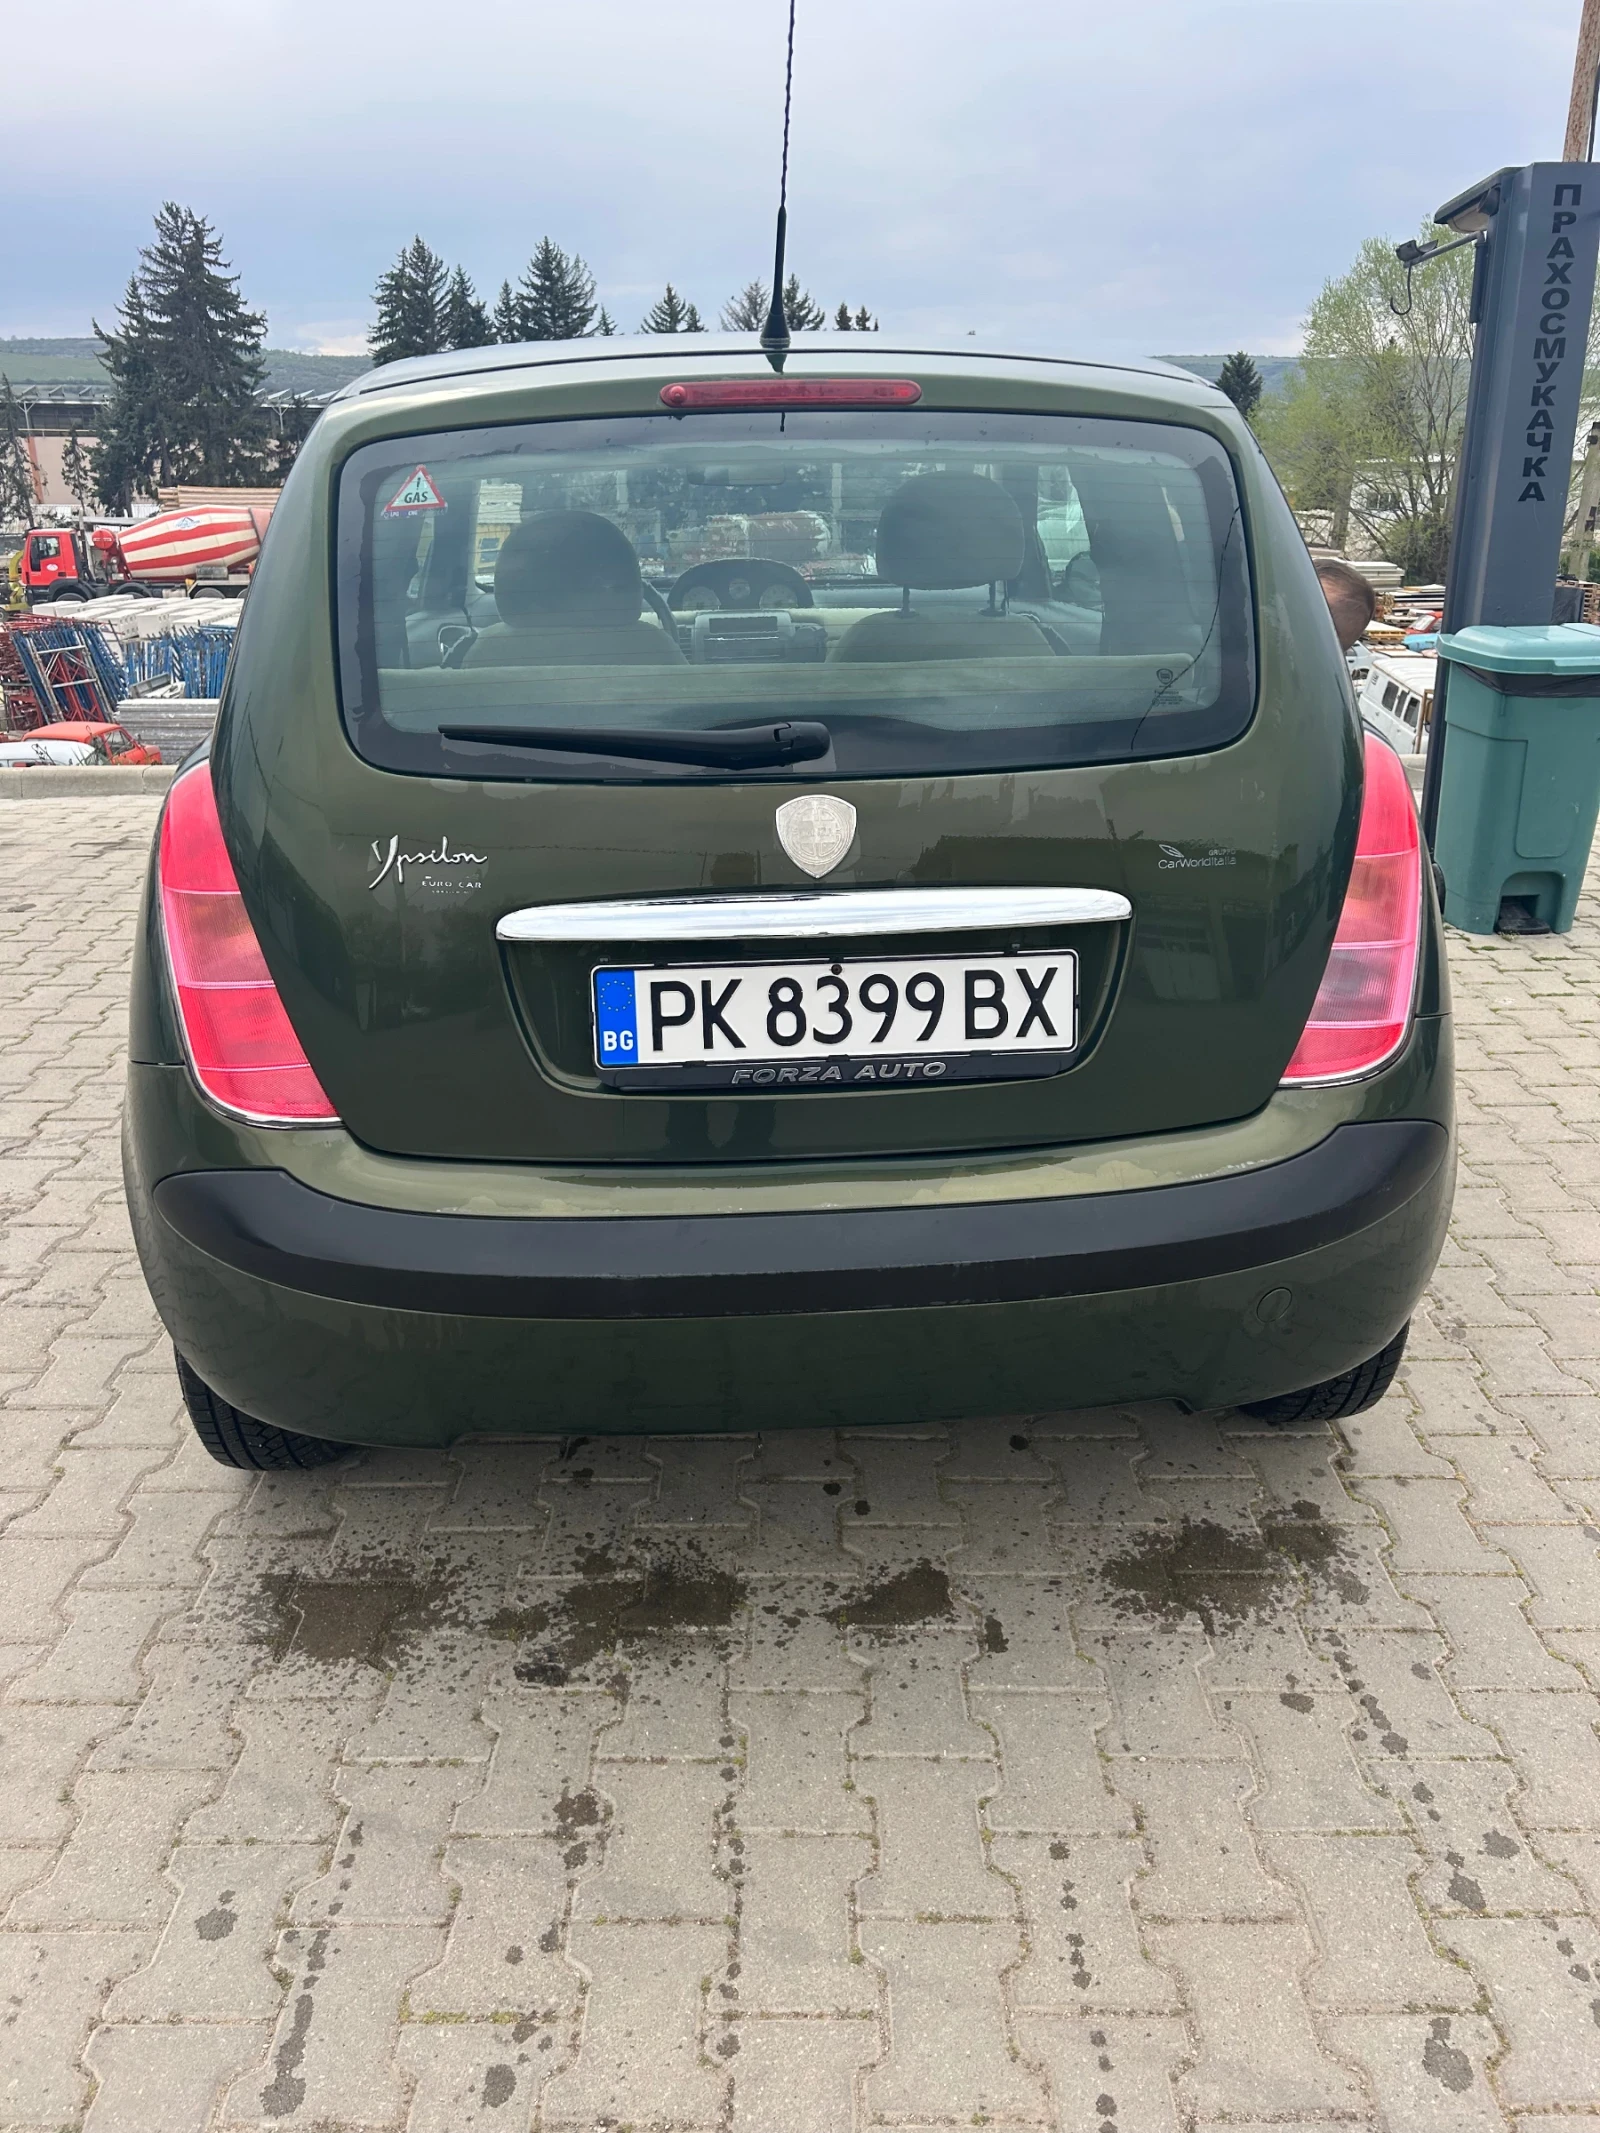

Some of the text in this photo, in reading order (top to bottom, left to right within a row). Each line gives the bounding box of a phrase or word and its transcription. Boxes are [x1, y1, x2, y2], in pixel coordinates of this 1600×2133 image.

[1518, 184, 1582, 502] ПРАХОСМУКАЧКА
[404, 491, 428, 504] GAS
[369, 834, 488, 889] Ypsilon
[649, 966, 1059, 1052] PK 8399 BX
[603, 1031, 634, 1052] BG
[731, 1061, 947, 1085] FORZA AUTO
